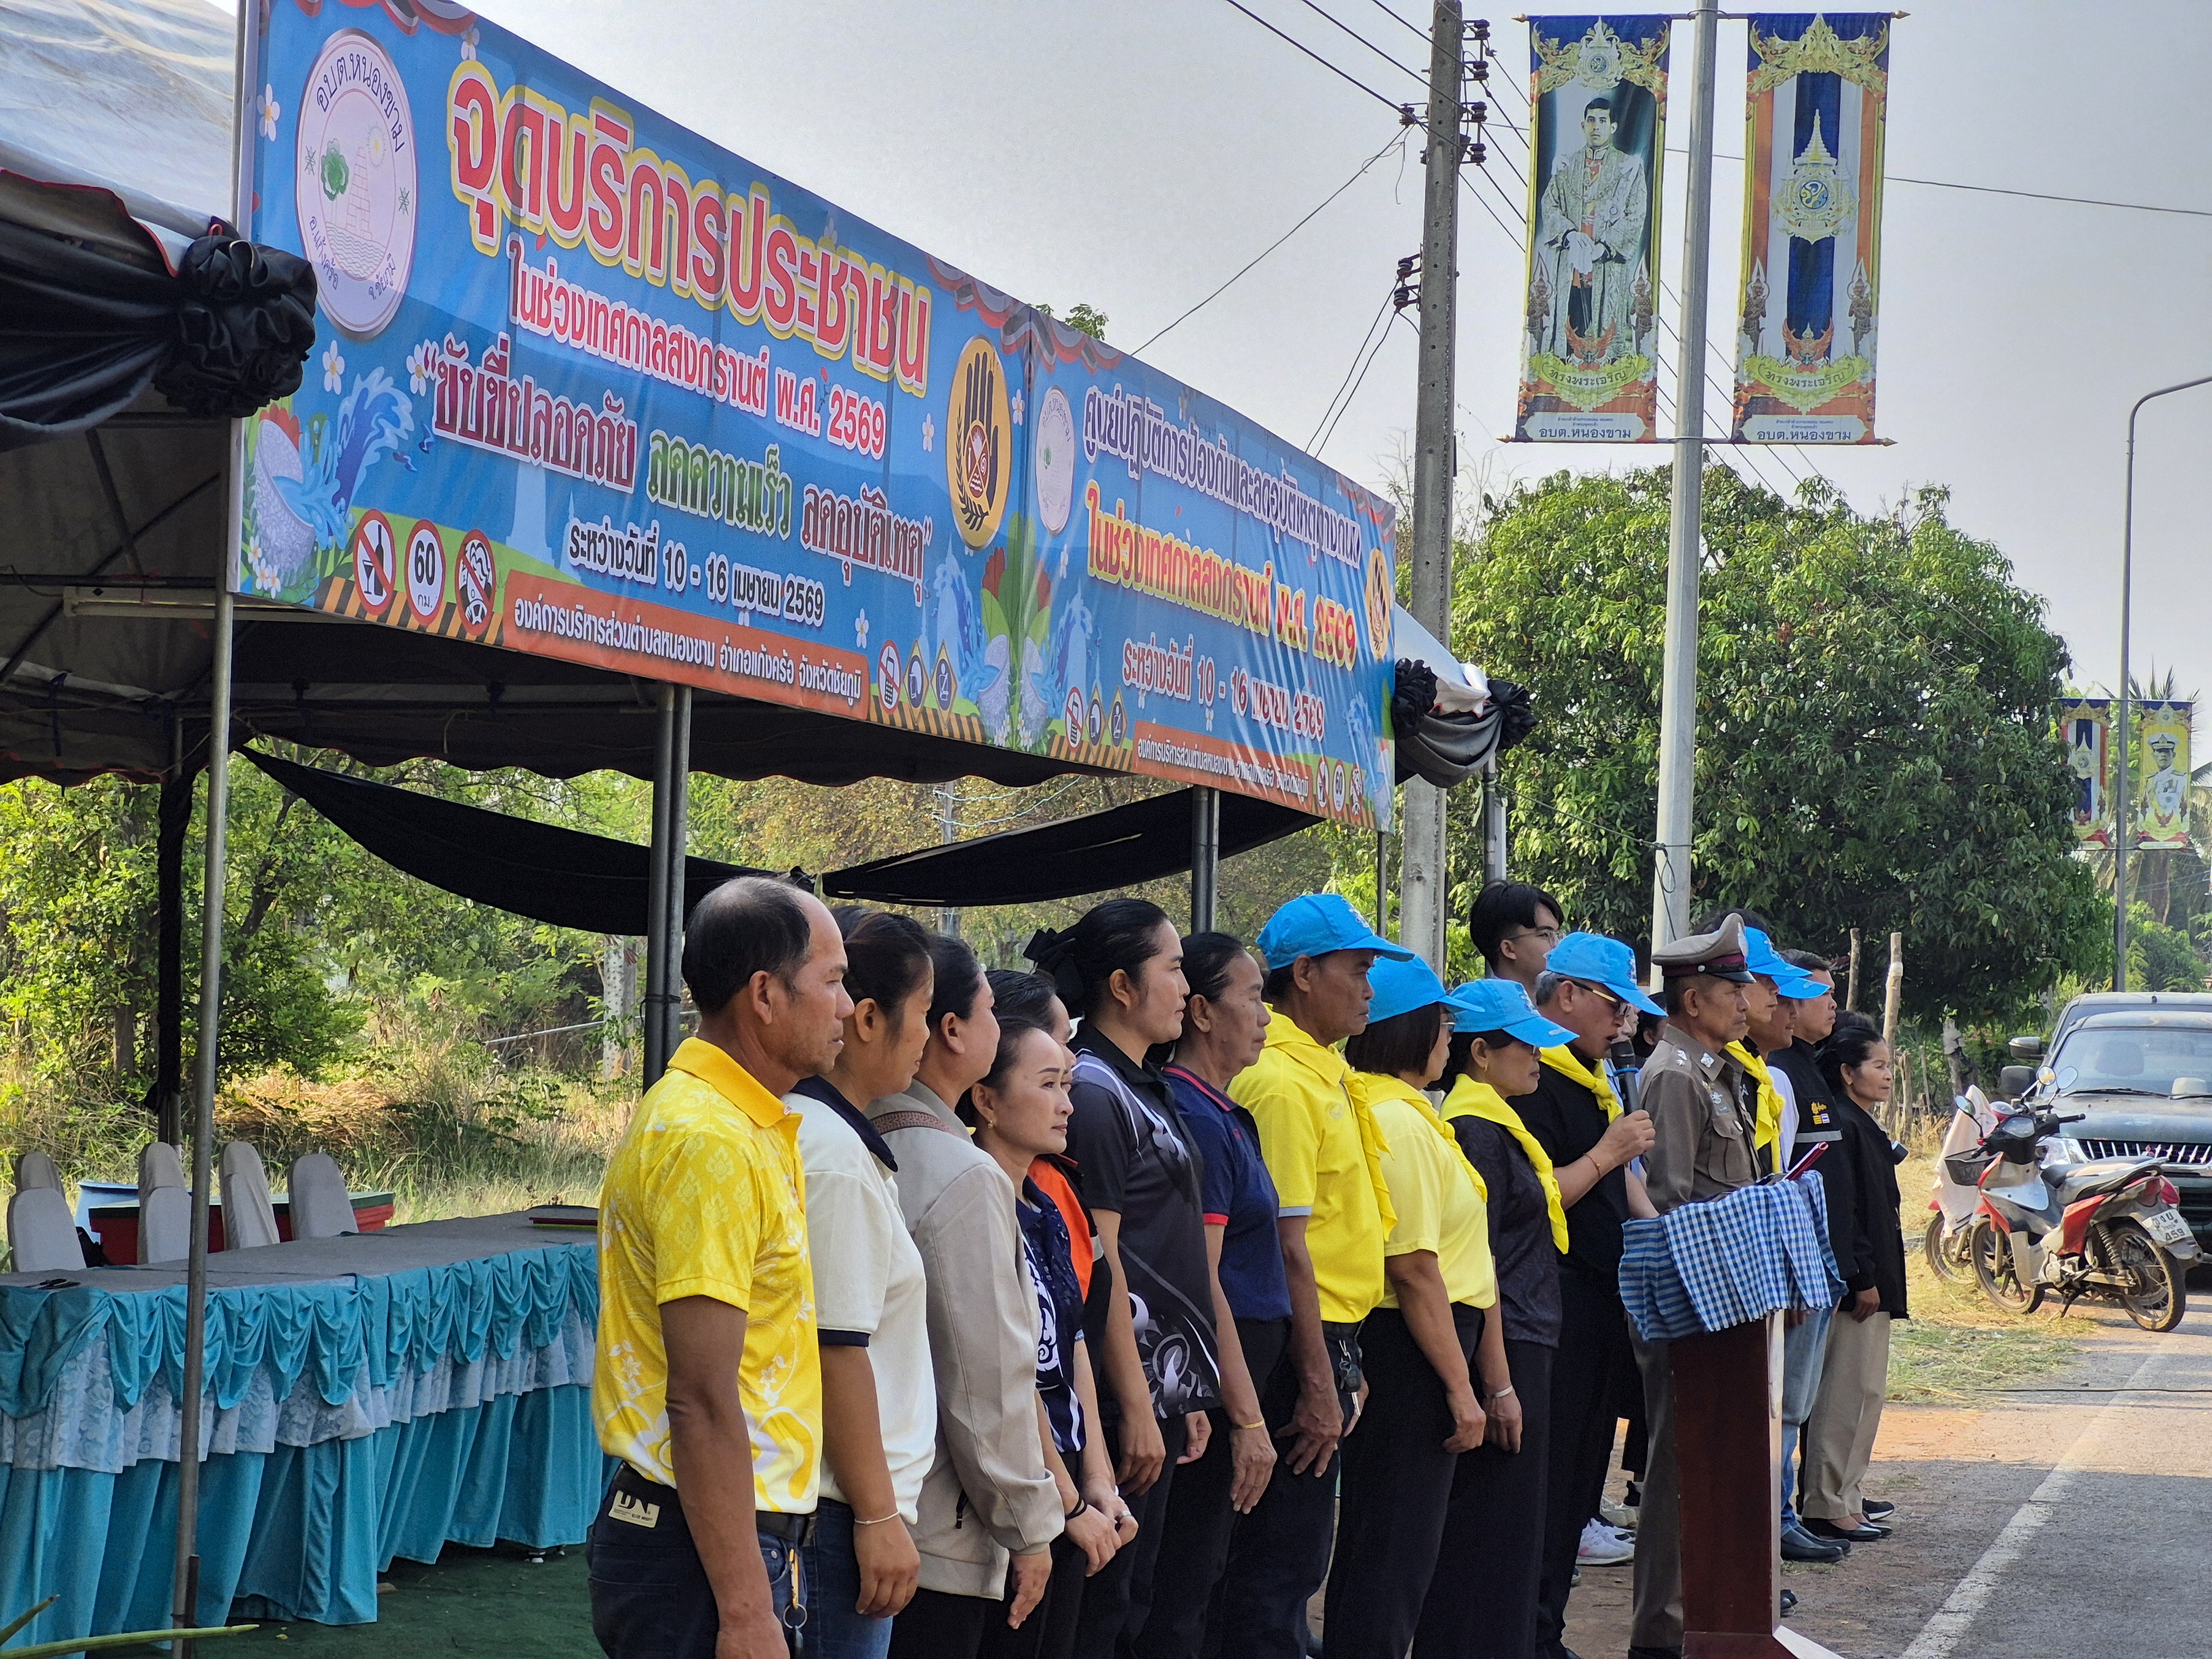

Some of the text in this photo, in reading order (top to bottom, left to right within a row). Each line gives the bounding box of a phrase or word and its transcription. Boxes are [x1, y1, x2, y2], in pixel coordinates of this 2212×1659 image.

[316, 53, 405, 153] อบต.หนองขาม
[451, 71, 930, 390] จุดบริการประชาชน
[509, 234, 885, 459] ในช่วงเทศกาลสงกรานต์ พ.ศ. 2569
[1549, 369, 1627, 386] ทรงพระเจริญ
[1765, 371, 1846, 387] ทรงพระเจริญ
[1539, 428, 1631, 438] อบต.หนองขาม
[1757, 431, 1851, 440] อบต.หนองขาม
[648, 431, 791, 539] ลดความเร็ว
[413, 540, 436, 585] 60
[569, 520, 659, 584] ระหว่างวันที่
[664, 540, 685, 591] 10
[707, 554, 728, 601] 16
[733, 565, 780, 613] เมษายน
[785, 576, 824, 625] 2569
[1086, 483, 1271, 635] ในช่วงเทศกาลสงกรานต์
[1314, 596, 1357, 670] 2569
[515, 599, 715, 667] องค์การบริหารส่วนตำบลหนองขาม
[799, 655, 862, 706] จังหวัดชัยภูมิ
[1123, 633, 1193, 700] ระหว่างวันที่
[1198, 656, 1214, 706] 10
[1231, 666, 1248, 716] 16
[1293, 690, 1324, 742] 2569
[1335, 770, 1343, 795] 60
